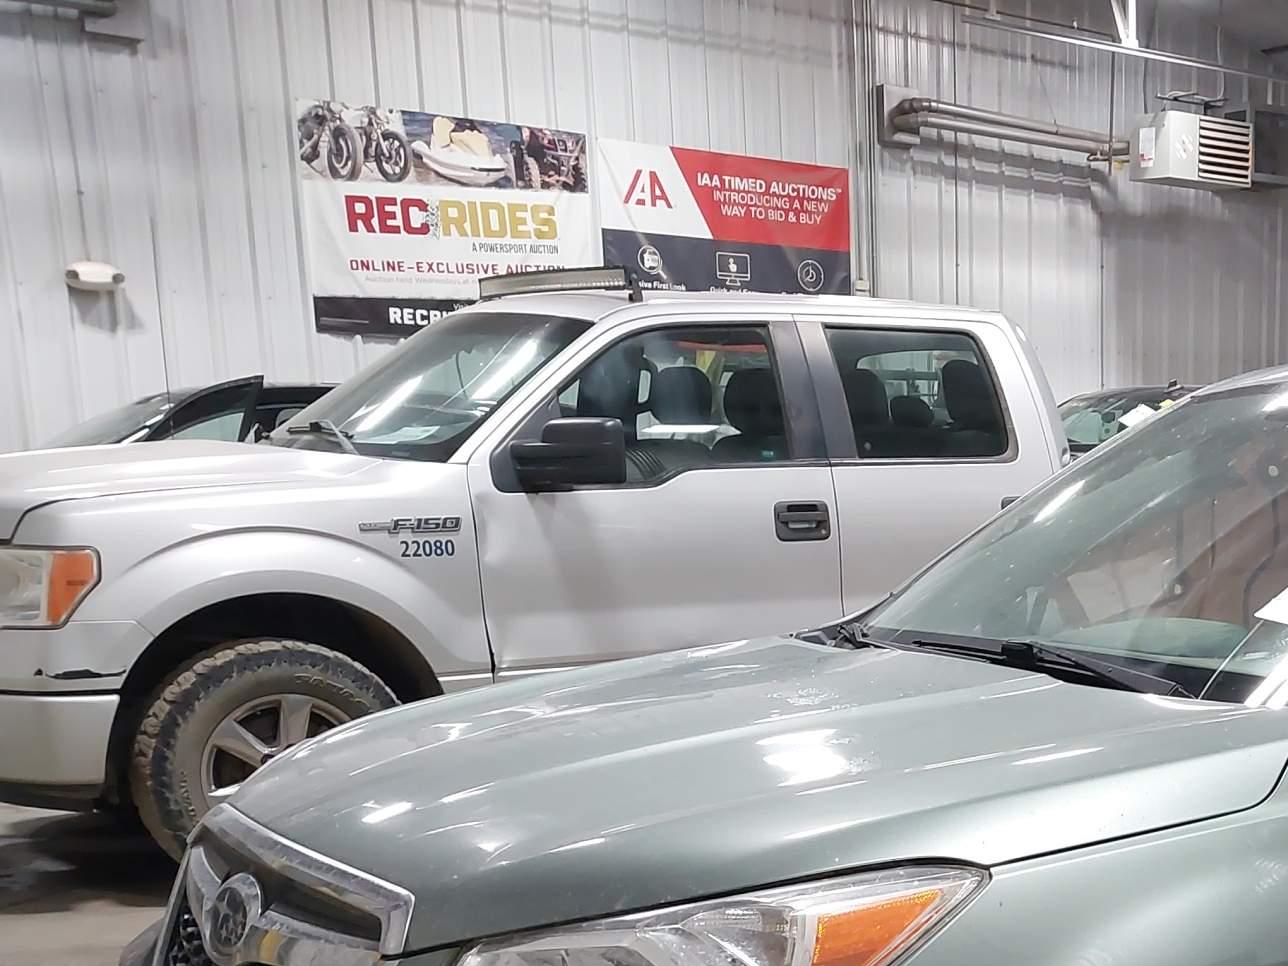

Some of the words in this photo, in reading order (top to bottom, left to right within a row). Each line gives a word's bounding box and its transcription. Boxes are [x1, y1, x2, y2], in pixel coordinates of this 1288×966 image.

[697, 172, 720, 188] IAA
[722, 175, 766, 192] TIMED
[713, 190, 789, 209] INTRODUCING
[792, 198, 801, 209] A
[803, 201, 829, 213] NEW
[344, 195, 430, 236] REC
[438, 199, 558, 240] RIDES
[720, 204, 747, 217] WAY
[750, 207, 765, 220] TO
[767, 209, 786, 222] BID
[787, 211, 797, 223] &
[799, 212, 822, 225] BUY
[472, 242, 477, 253] A
[478, 242, 527, 254] POWERSPORT
[529, 244, 559, 254] AUCTION
[350, 259, 499, 275] ONLINE-EXCLUSIVE
[391, 517, 461, 533] F-150
[400, 539, 455, 558] 22080
